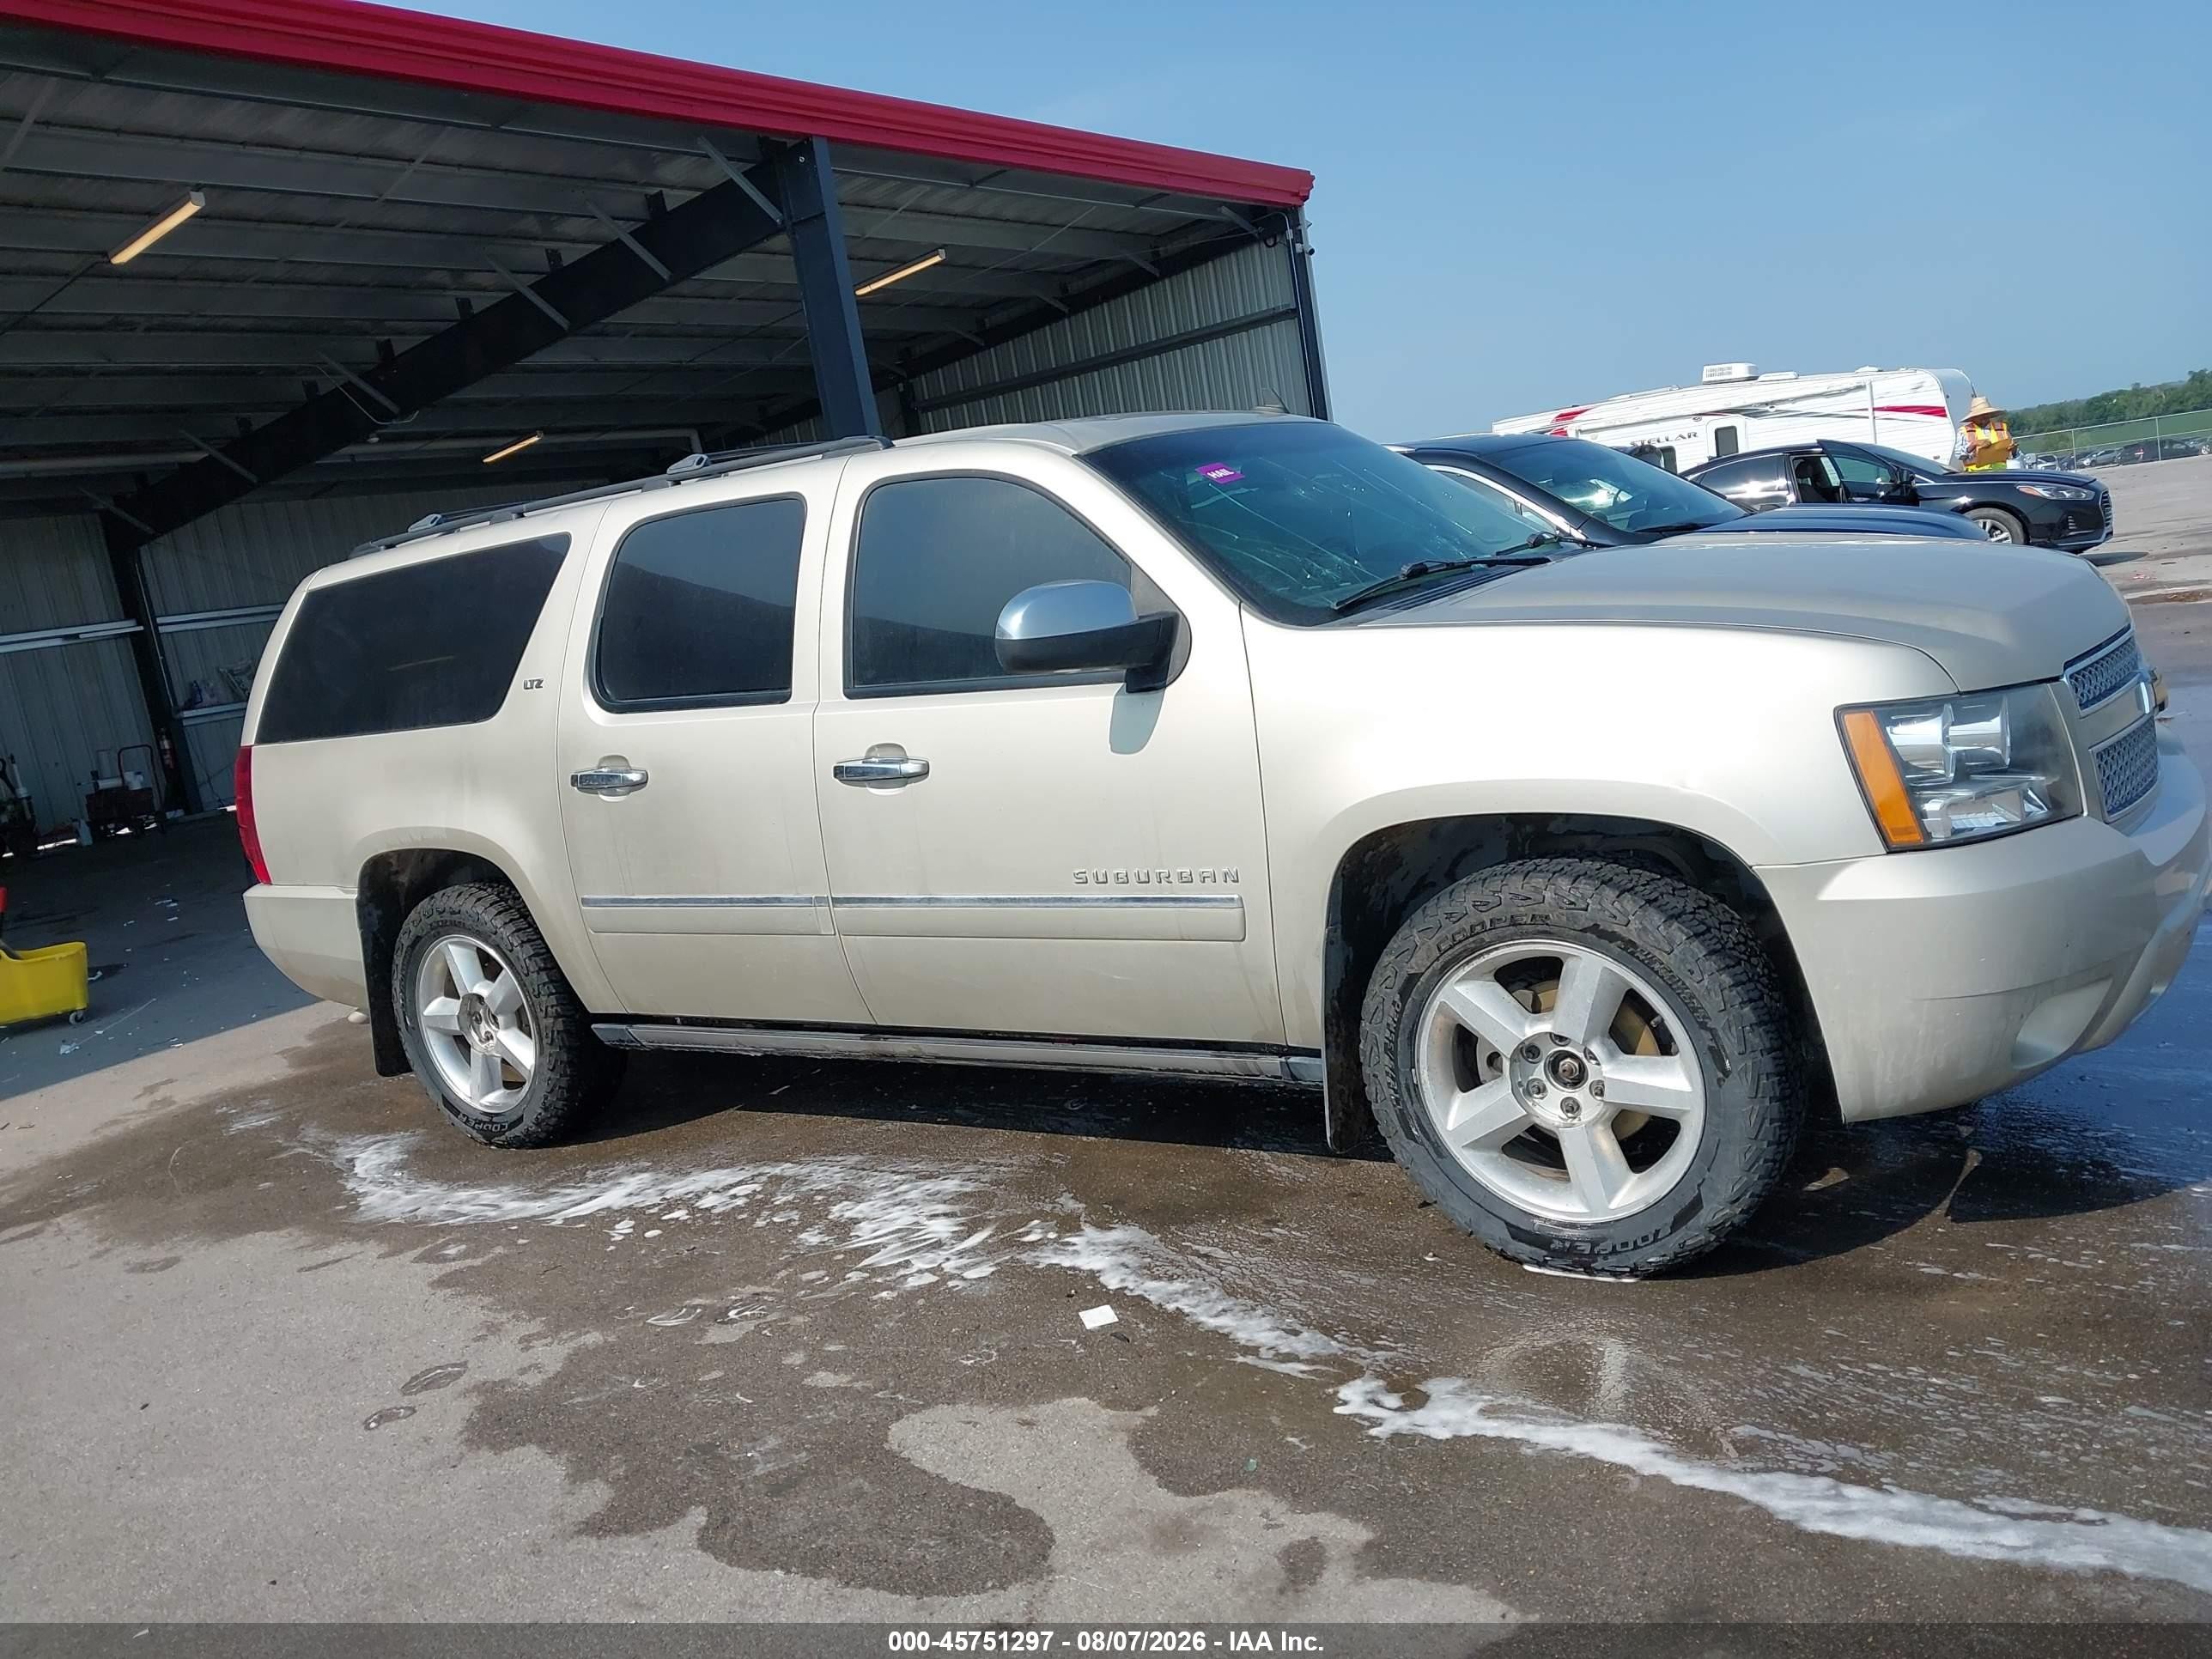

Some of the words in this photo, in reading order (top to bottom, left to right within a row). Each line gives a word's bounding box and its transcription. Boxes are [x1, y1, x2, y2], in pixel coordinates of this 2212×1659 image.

[1630, 432, 1698, 447] STELLAR
[523, 678, 544, 690] LTZ
[1073, 867, 1240, 884] SUBURBAN
[1436, 913, 1551, 952] COOPER
[458, 1113, 508, 1132] COOPER
